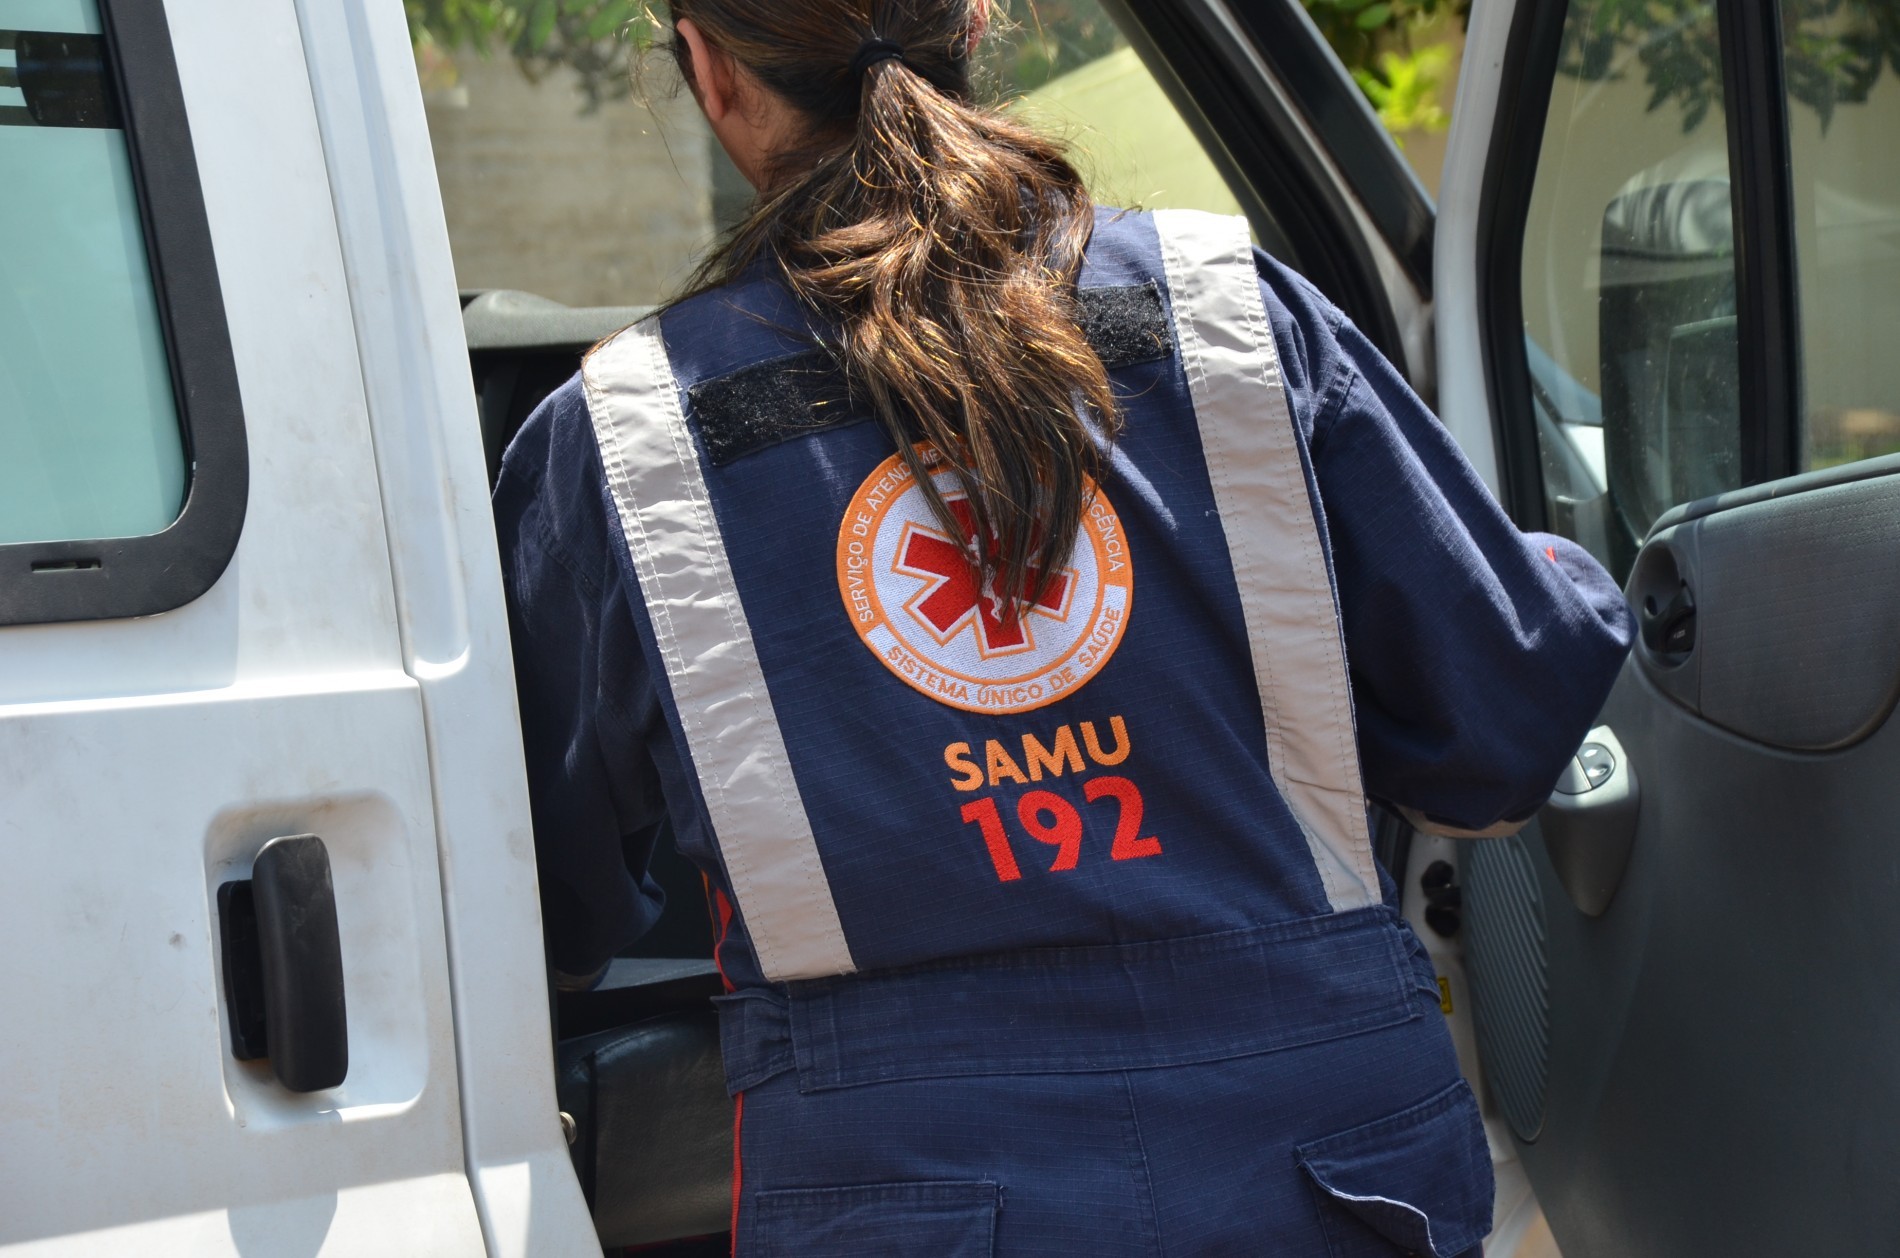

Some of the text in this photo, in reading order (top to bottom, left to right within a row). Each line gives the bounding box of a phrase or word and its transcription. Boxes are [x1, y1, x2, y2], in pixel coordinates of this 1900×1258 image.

[852, 512, 873, 537] DE
[846, 540, 874, 622] SERVIÇO
[888, 607, 1121, 705] SISTEMA ÚNICO DE SAÚDE
[944, 715, 1131, 791] SAMU
[960, 775, 1163, 882] 192
